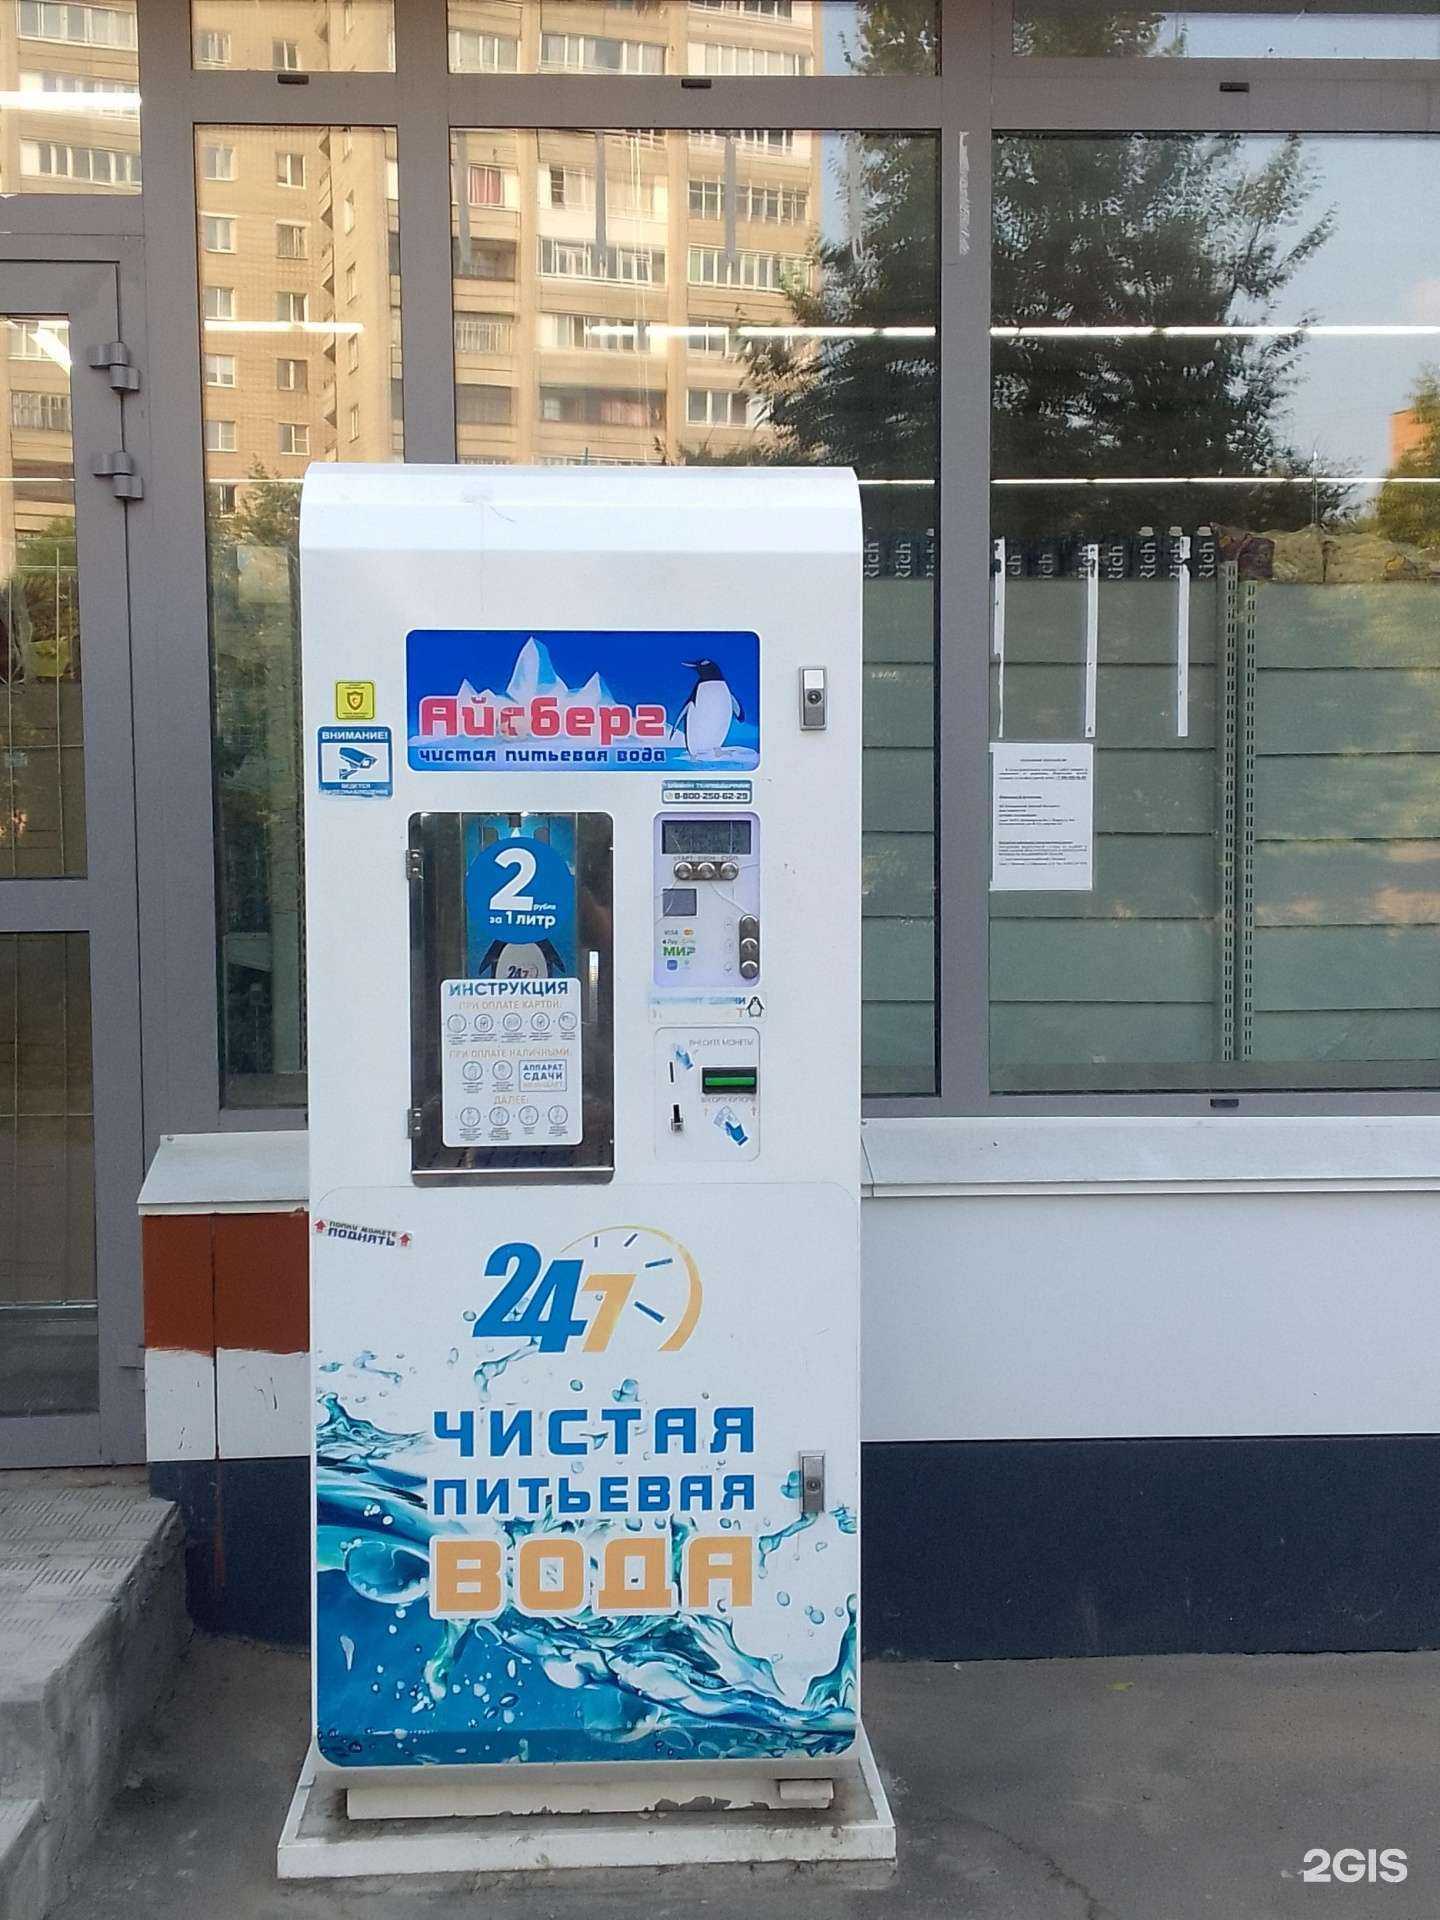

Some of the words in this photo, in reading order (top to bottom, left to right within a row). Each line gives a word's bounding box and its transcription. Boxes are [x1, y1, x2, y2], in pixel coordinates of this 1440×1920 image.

[322, 731, 388, 740] ВНИМАНИЕ!
[420, 749, 496, 762] чистая
[505, 750, 607, 762] питьевая
[616, 748, 665, 762] вода
[489, 847, 537, 911] 2
[505, 911, 513, 925] 1
[515, 914, 556, 929] литр
[663, 946, 696, 956] МИР
[449, 980, 568, 997] ИНСТРУКЦИЯ
[523, 1071, 563, 1081] СДАЧИ
[327, 1227, 395, 1247] ПОДНЯТЬ
[433, 1407, 755, 1458] ЧИСТАЯ
[433, 1474, 755, 1516] ПИТЬЕВАЯ
[435, 1535, 753, 1612] ВОДА
